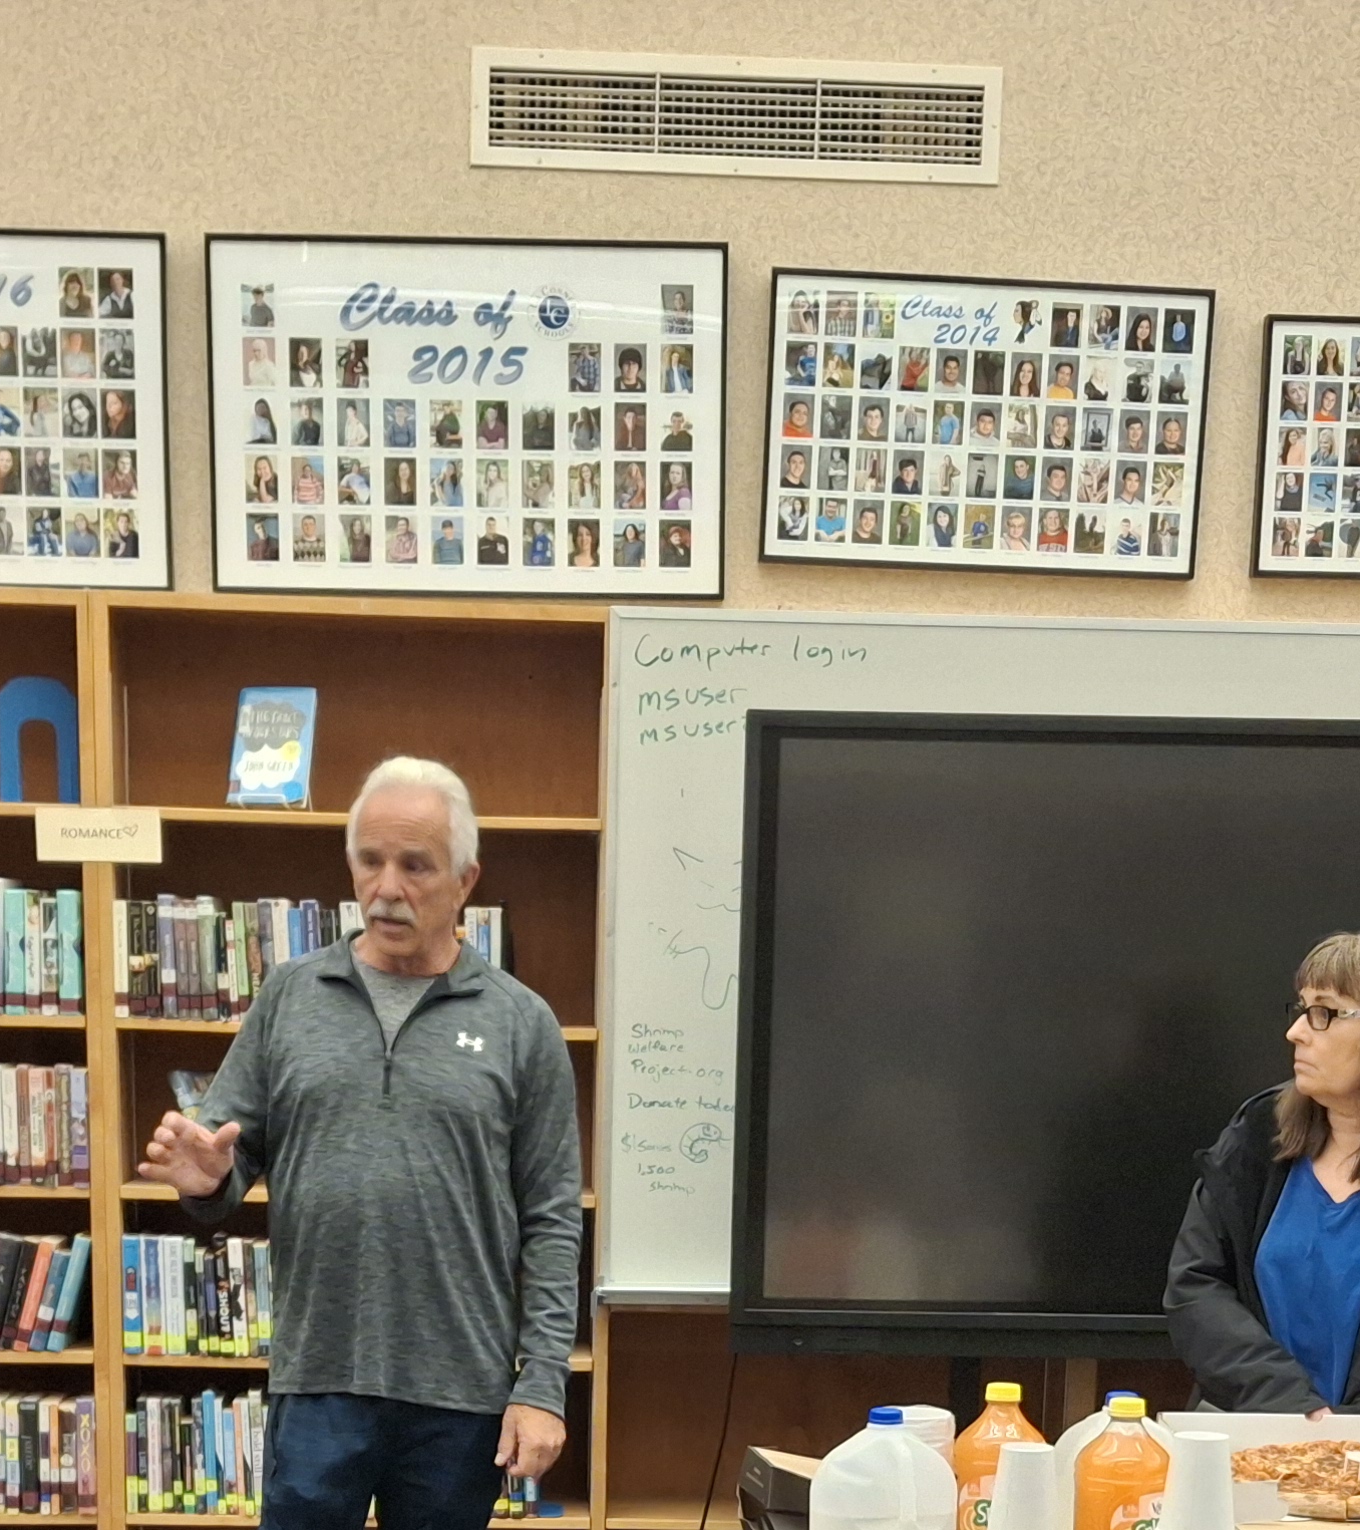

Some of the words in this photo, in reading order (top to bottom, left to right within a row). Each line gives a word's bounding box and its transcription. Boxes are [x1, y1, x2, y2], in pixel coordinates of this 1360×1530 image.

[340, 282, 458, 331] Class
[474, 290, 517, 337] of
[901, 294, 965, 321] Class
[974, 300, 998, 327] of
[934, 323, 1001, 346] 2014
[407, 345, 528, 385] 2015
[634, 633, 772, 671] Computer
[793, 635, 868, 667] login
[59, 826, 124, 841] ROMANCE
[627, 1092, 687, 1110] Donate
[218, 1291, 230, 1332] SHOUT
[80, 1413, 92, 1473] XOXO
